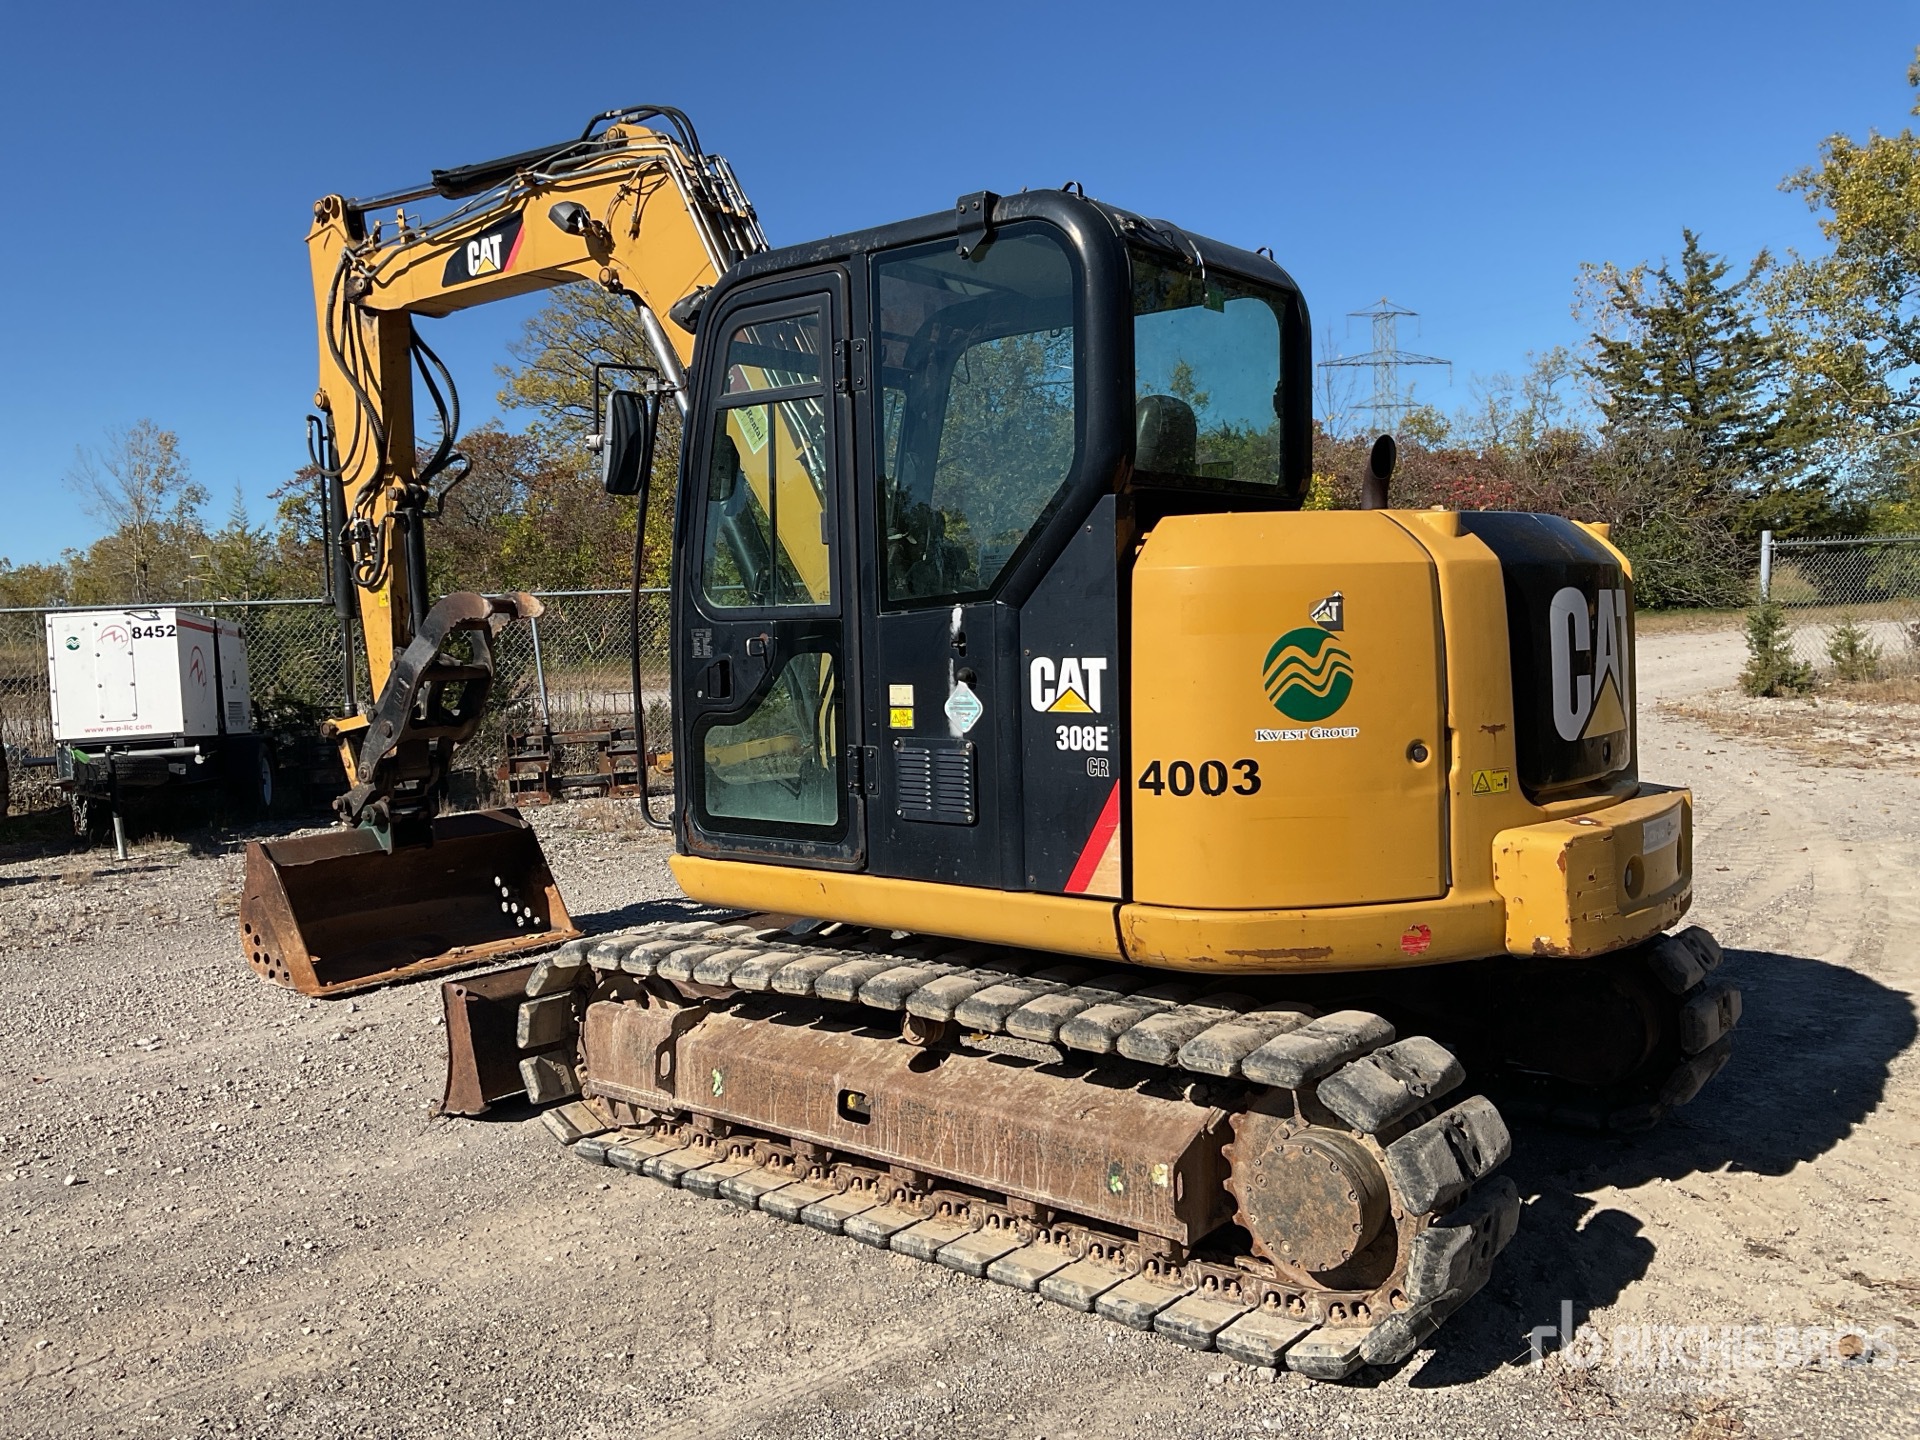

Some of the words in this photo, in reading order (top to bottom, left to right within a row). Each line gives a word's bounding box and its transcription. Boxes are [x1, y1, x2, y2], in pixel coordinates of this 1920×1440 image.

[467, 234, 502, 277] CAT
[745, 409, 764, 441] Rental
[131, 625, 177, 639] 8452
[1550, 586, 1630, 741] CAT
[1029, 657, 1107, 714] CAT
[84, 724, 153, 733] wwwm-p-llccom
[1055, 726, 1109, 751] 308E
[1255, 729, 1307, 742] KWEST
[1309, 727, 1360, 740] GROUP
[1086, 757, 1110, 777] CR
[1138, 759, 1262, 797] 4003
